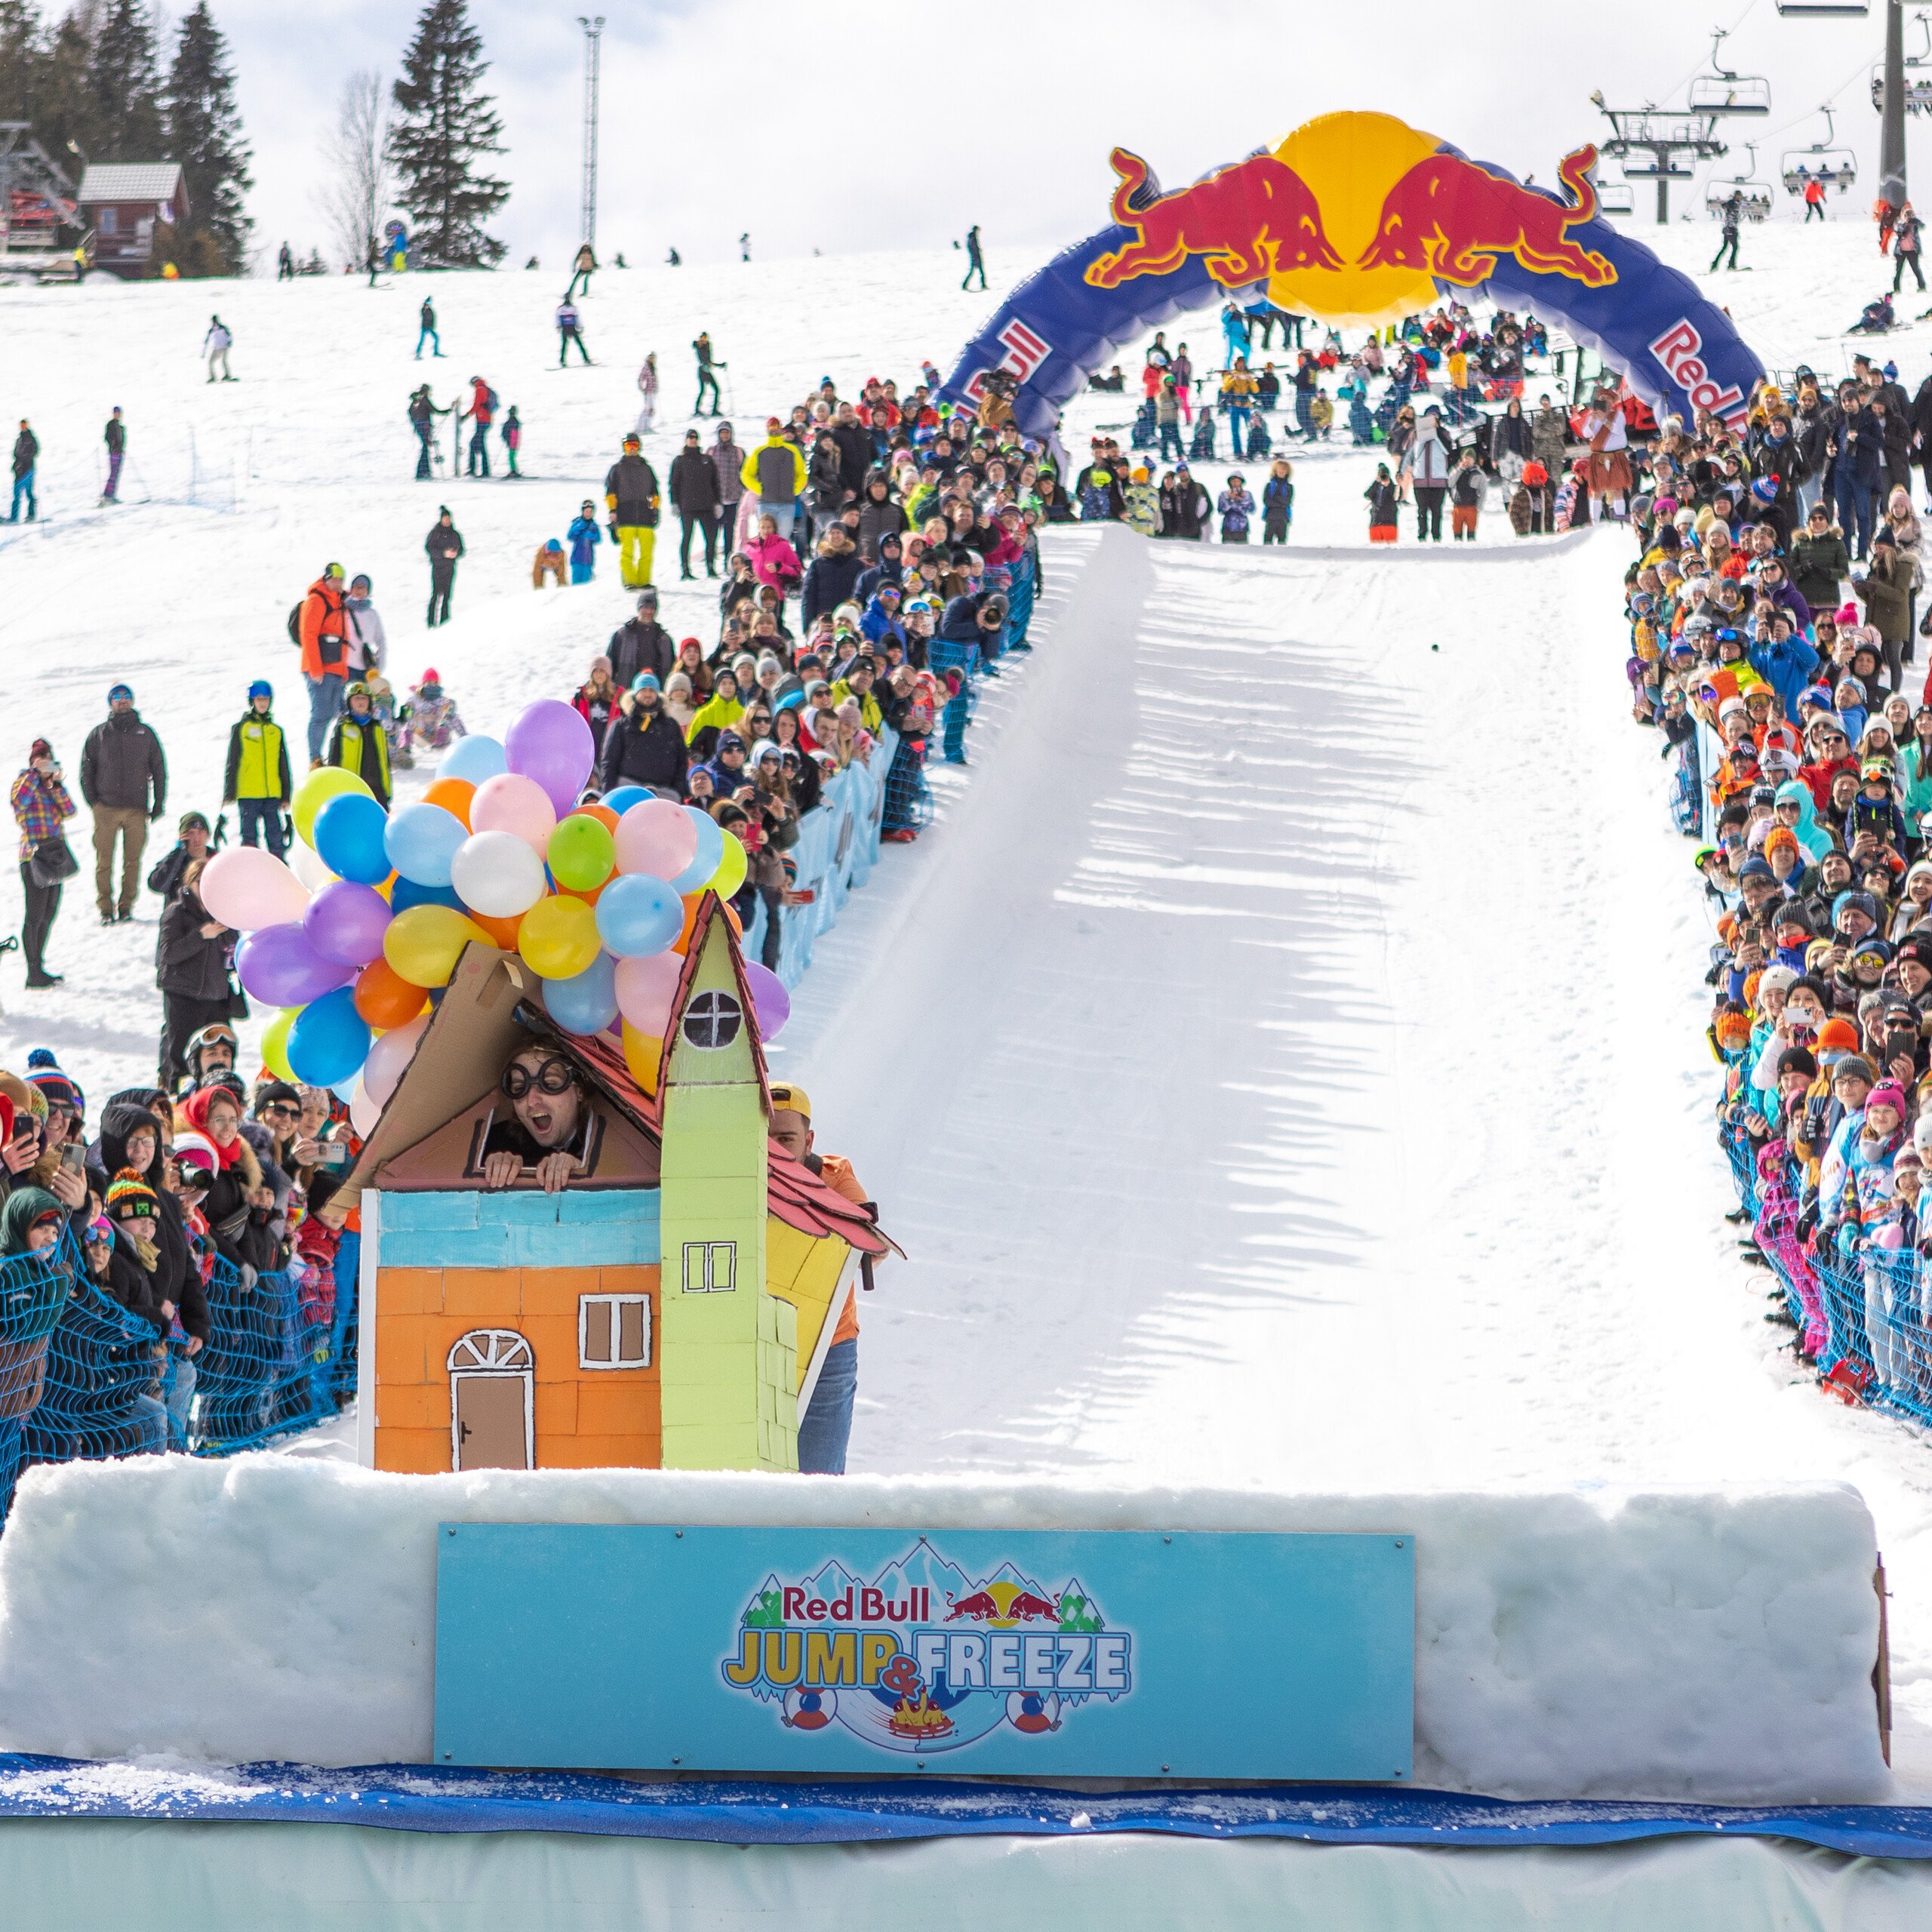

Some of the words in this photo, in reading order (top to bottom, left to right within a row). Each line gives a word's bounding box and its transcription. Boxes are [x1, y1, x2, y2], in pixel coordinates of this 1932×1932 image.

[1650, 319, 1743, 414] Red
[782, 1586, 854, 1621] Red
[860, 1587, 930, 1623] Bull
[724, 1631, 900, 1686] JUMP
[881, 1654, 921, 1697] &
[915, 1633, 1131, 1690] FREEZE
